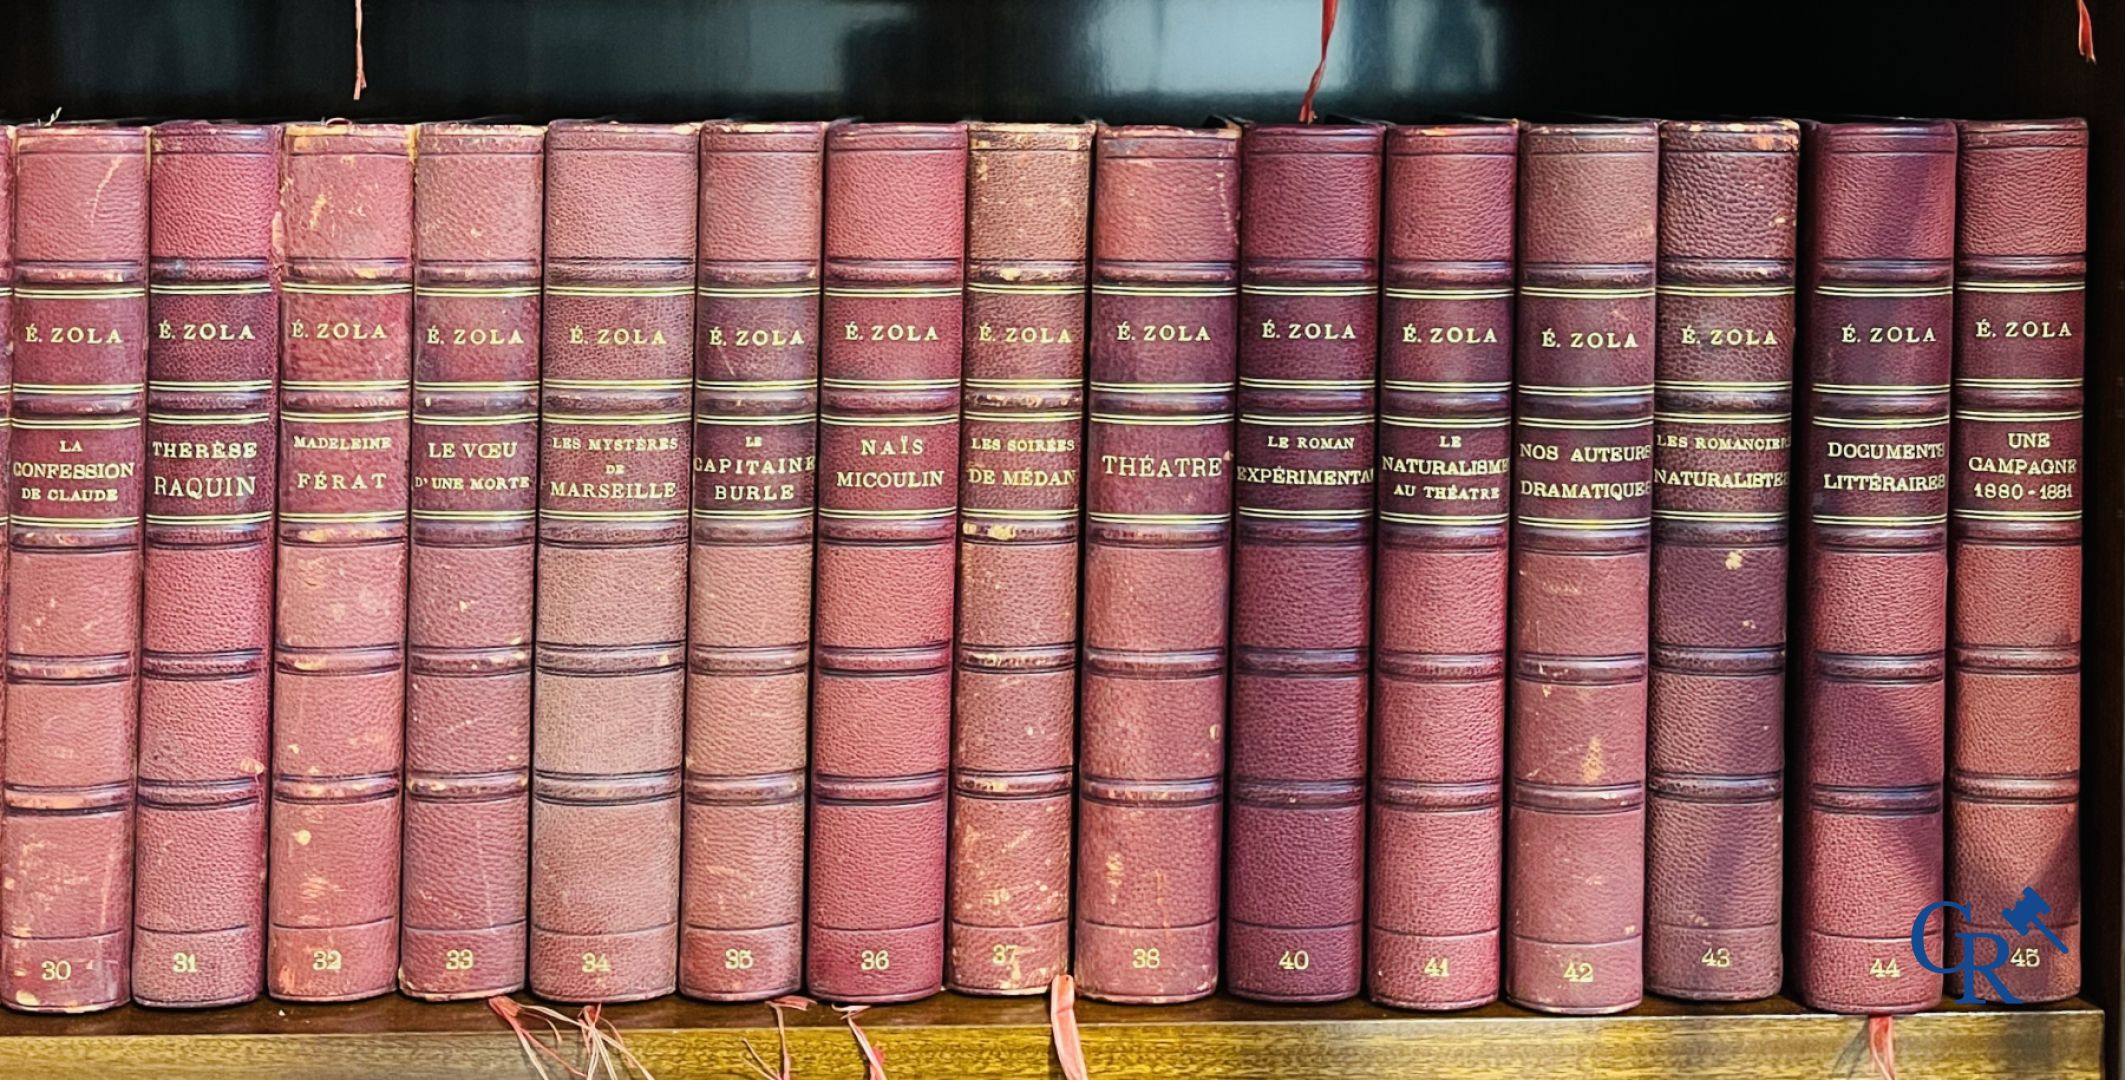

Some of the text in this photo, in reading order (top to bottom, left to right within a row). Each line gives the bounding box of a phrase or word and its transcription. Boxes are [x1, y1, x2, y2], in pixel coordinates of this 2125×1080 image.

[25, 324, 124, 344] É. ZOLA
[158, 321, 255, 341] É. ZOLA
[291, 322, 387, 339] É. ZOLA
[427, 327, 524, 345] É. ZOLA
[569, 326, 666, 345] É. ZOLA
[709, 327, 804, 346] É. ZOLA
[845, 322, 939, 341] É. ZOLA
[979, 324, 1072, 344] É. ZOLA
[1116, 322, 1211, 342] É. ZOLA
[1262, 321, 1356, 340] É. ZOLA
[1403, 326, 1497, 343] É. ZOLA
[1681, 325, 1778, 345] É. ZOLA
[1842, 324, 1936, 343] É. ZOLA
[1976, 320, 2072, 338] É. ZOLA
[1541, 330, 1638, 348] É. ZOLA
[59, 440, 82, 452] LA
[294, 436, 391, 450] MADELEINE
[553, 436, 678, 451] LES MYSTÈRES
[745, 436, 762, 447] LE
[861, 436, 924, 455] NAÏS
[972, 437, 1075, 452] LES SOIRÉES
[1268, 436, 1354, 449] LE ROMAN
[1439, 436, 1462, 448] LE
[1657, 435, 1688, 448] LES
[2008, 433, 2050, 448] UNE
[429, 443, 455, 458] LE
[1520, 444, 1559, 460] NOS
[13, 462, 135, 479] CONFESSION
[606, 463, 624, 475] DE
[1102, 454, 1222, 478] THÉATRE
[1382, 456, 1510, 476] NATURALISME
[1968, 457, 2077, 474] CAMPAGNE
[154, 476, 256, 499] RAQUIN
[298, 472, 387, 490] FÉRAT
[470, 477, 530, 490] MORTE
[836, 471, 944, 488] MICOULIN
[968, 469, 1076, 487] DE MÉDAN
[1824, 473, 1945, 492] LITTÉRAIRES
[22, 488, 118, 501] DE CLAUDE
[550, 482, 677, 499] MARSEILLE
[715, 485, 794, 500] BURLE
[1394, 484, 1500, 500] AU THÉATRE
[173, 952, 198, 973] 31
[312, 950, 342, 971] 32
[446, 950, 474, 969] 33
[581, 952, 611, 973] 34
[725, 949, 754, 969] 35
[860, 950, 890, 971] 36
[992, 944, 1018, 965] 37
[1132, 949, 1161, 968] 38
[1278, 950, 1309, 971] 40
[1700, 947, 1730, 968] 43
[2010, 948, 2040, 968] 45
[41, 960, 72, 981] 30
[1423, 956, 1451, 978] 41
[1562, 962, 1595, 982] 42
[1870, 958, 1901, 978] 44
